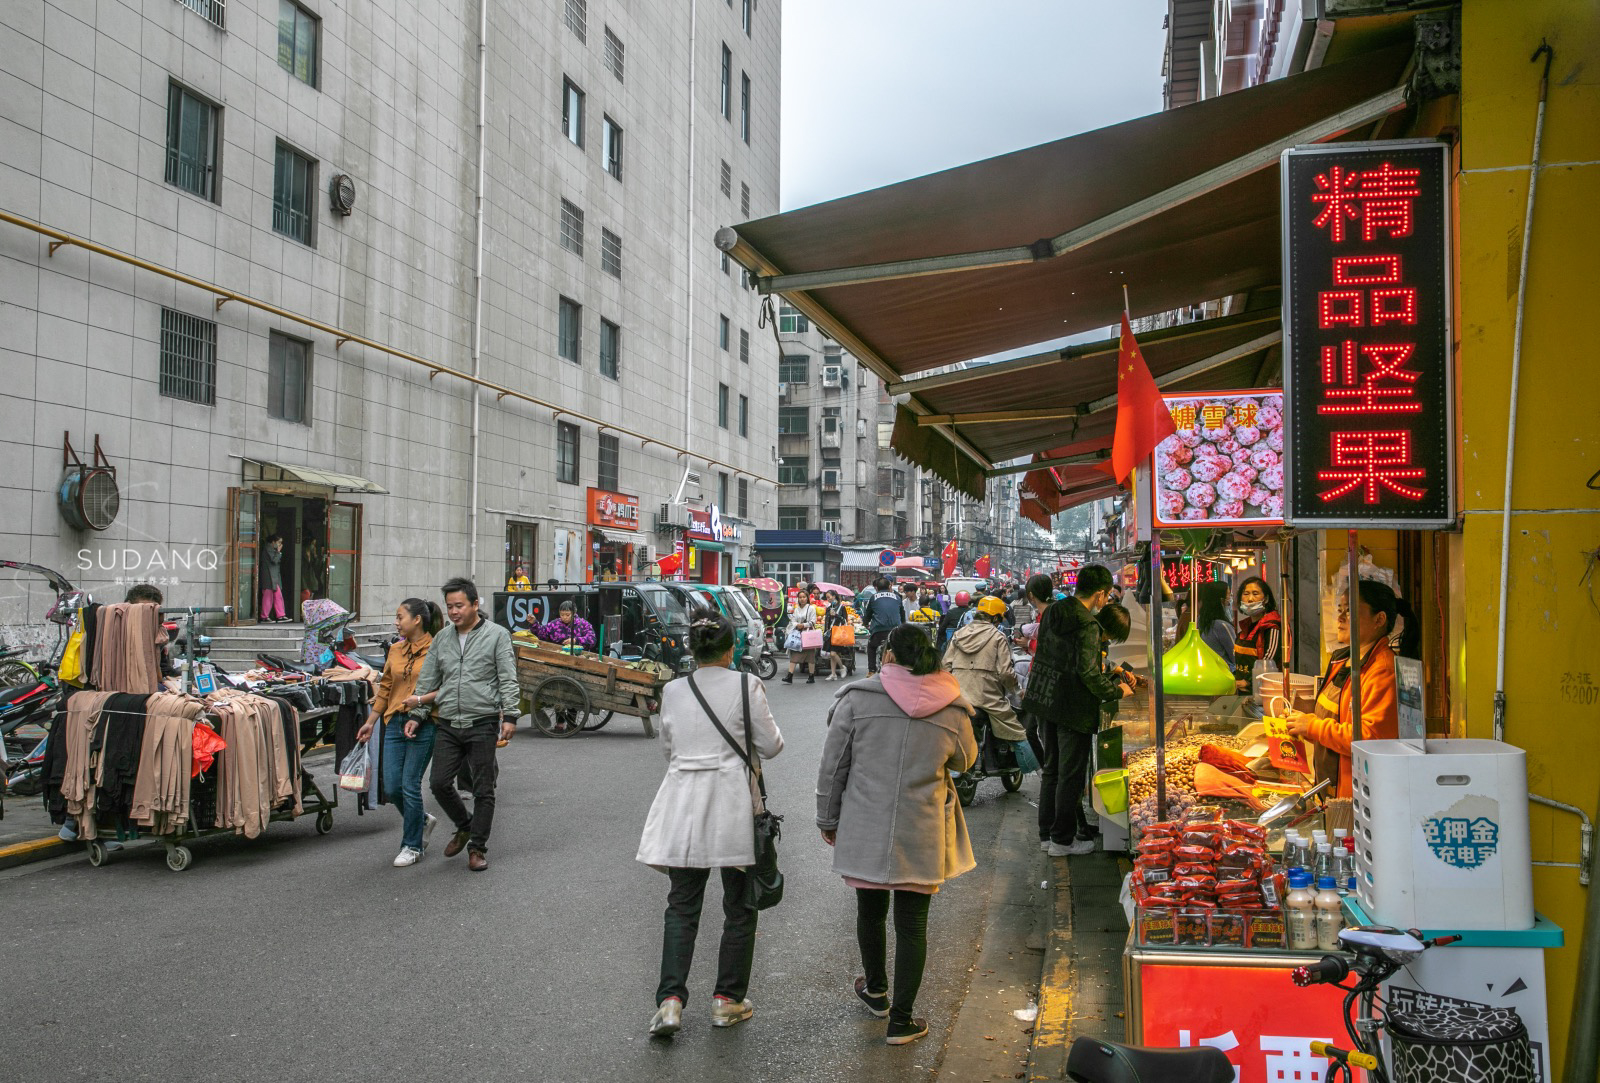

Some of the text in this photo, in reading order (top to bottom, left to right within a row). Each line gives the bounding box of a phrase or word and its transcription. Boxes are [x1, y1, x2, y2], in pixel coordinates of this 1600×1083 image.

[1171, 403, 1258, 431] 糖雪球
[1312, 162, 1428, 504] 精品坚果
